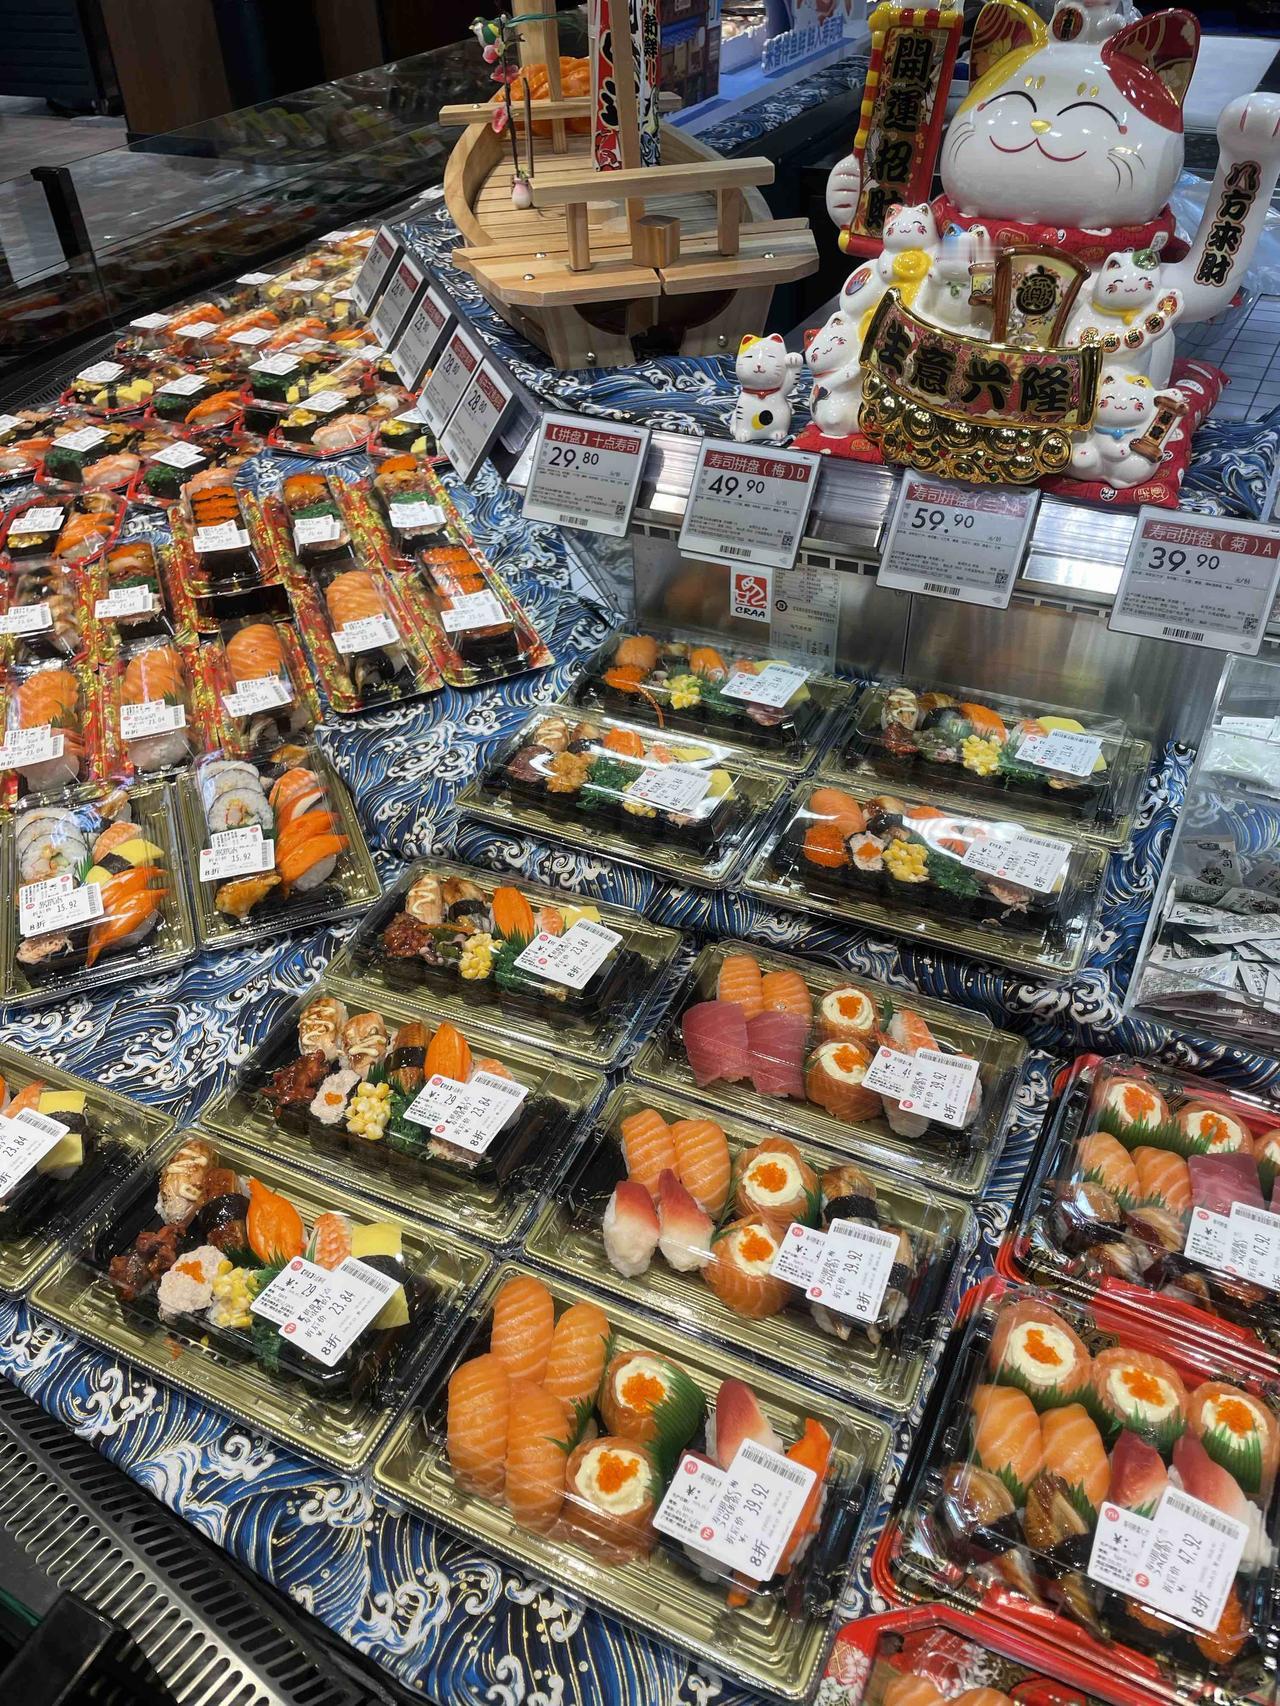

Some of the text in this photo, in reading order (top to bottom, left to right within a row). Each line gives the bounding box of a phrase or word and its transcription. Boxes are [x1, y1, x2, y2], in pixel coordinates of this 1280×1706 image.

[1198, 163, 1257, 284] 八方來財
[879, 319, 1070, 412] 生意兴隆
[468, 390, 487, 413] 28.80
[551, 427, 640, 454] 【拼盘】十点寿司
[549, 446, 599, 470] 29.80
[709, 453, 805, 480] 寿司拼盘（梅）D
[708, 474, 765, 498] 49.90
[911, 507, 975, 534] 59.90
[1149, 524, 1272, 555] 寿司拼盘（菊）A
[1148, 546, 1220, 575] 39.90
[735, 606, 765, 618] CRAA
[470, 1129, 487, 1146] 8折
[842, 1250, 864, 1275] 39.92
[301, 1283, 318, 1298] 29
[328, 1289, 355, 1316] 23.84
[856, 1291, 873, 1313] 8折
[320, 1333, 342, 1356] 8折
[743, 1483, 770, 1516] 39.92
[750, 1539, 770, 1567] 8折
[1178, 1533, 1202, 1566] 47.92
[1191, 1589, 1212, 1618] 8折
